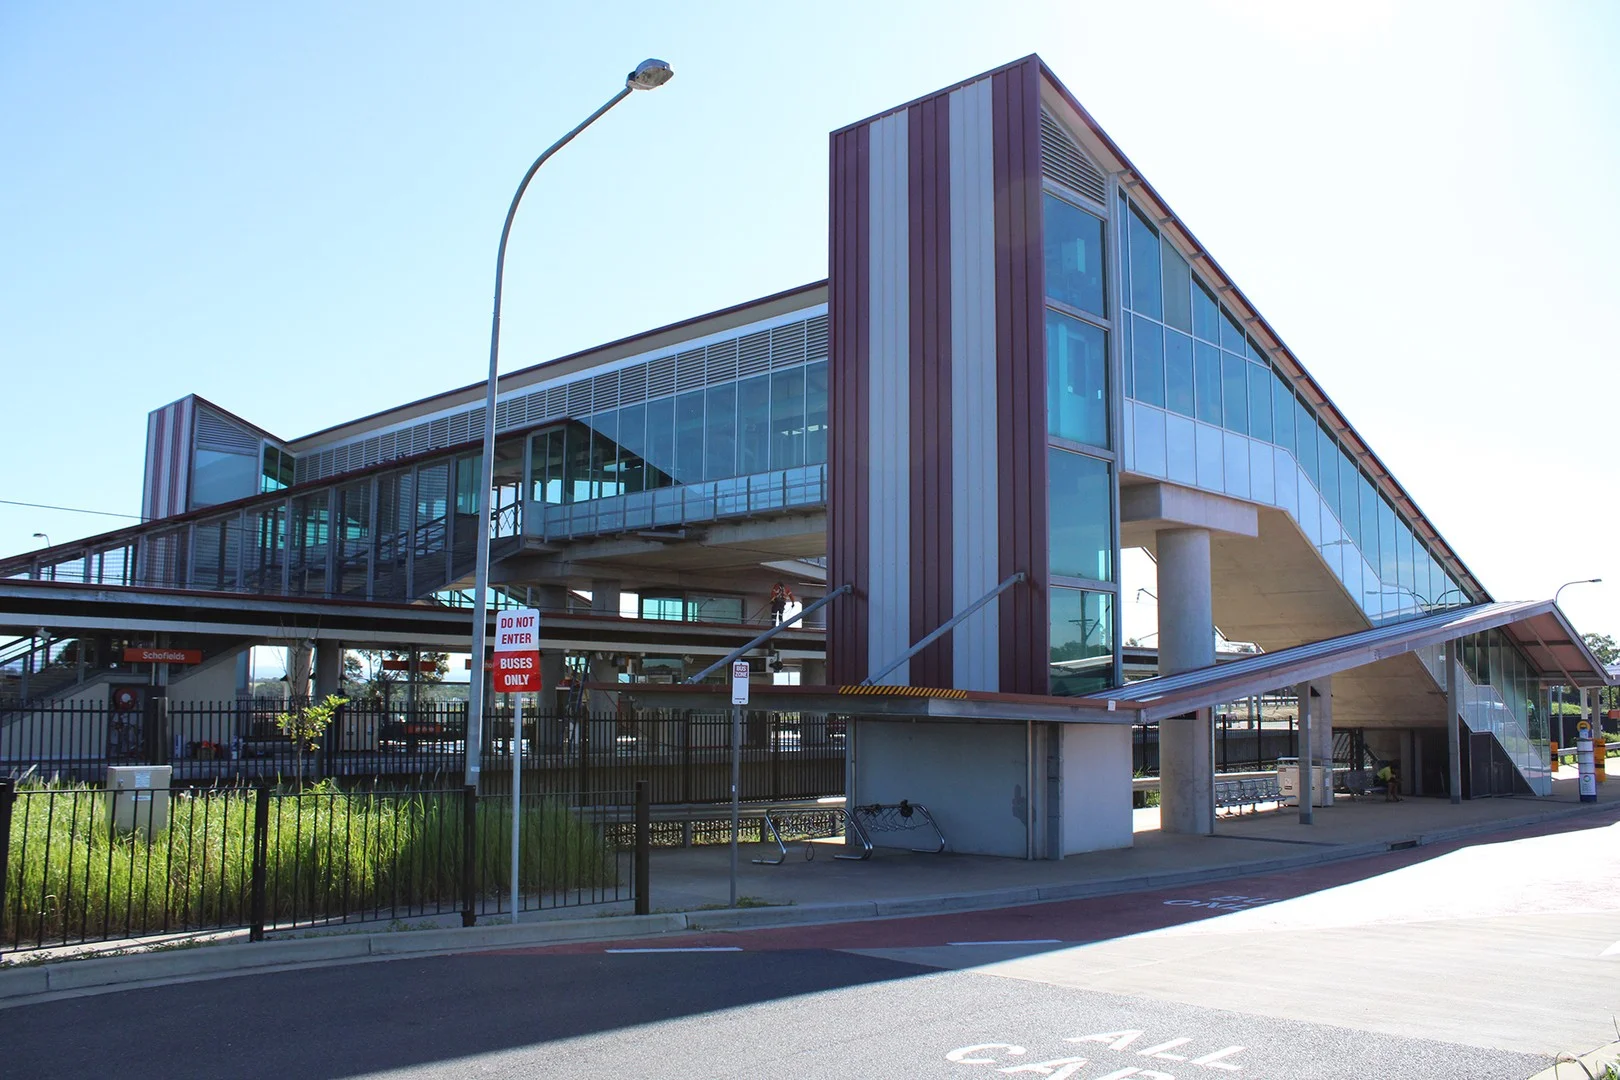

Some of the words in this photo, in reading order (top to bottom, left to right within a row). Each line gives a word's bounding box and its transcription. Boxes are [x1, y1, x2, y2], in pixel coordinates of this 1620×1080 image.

[501, 618, 514, 629] DO
[516, 616, 535, 628] NOT
[501, 633, 532, 645] ENTER
[142, 651, 186, 661] Schofields
[500, 657, 533, 670] BUSES
[504, 674, 530, 686] ONLY
[1162, 899, 1249, 911] ONL
[1063, 1029, 1247, 1072] ALL
